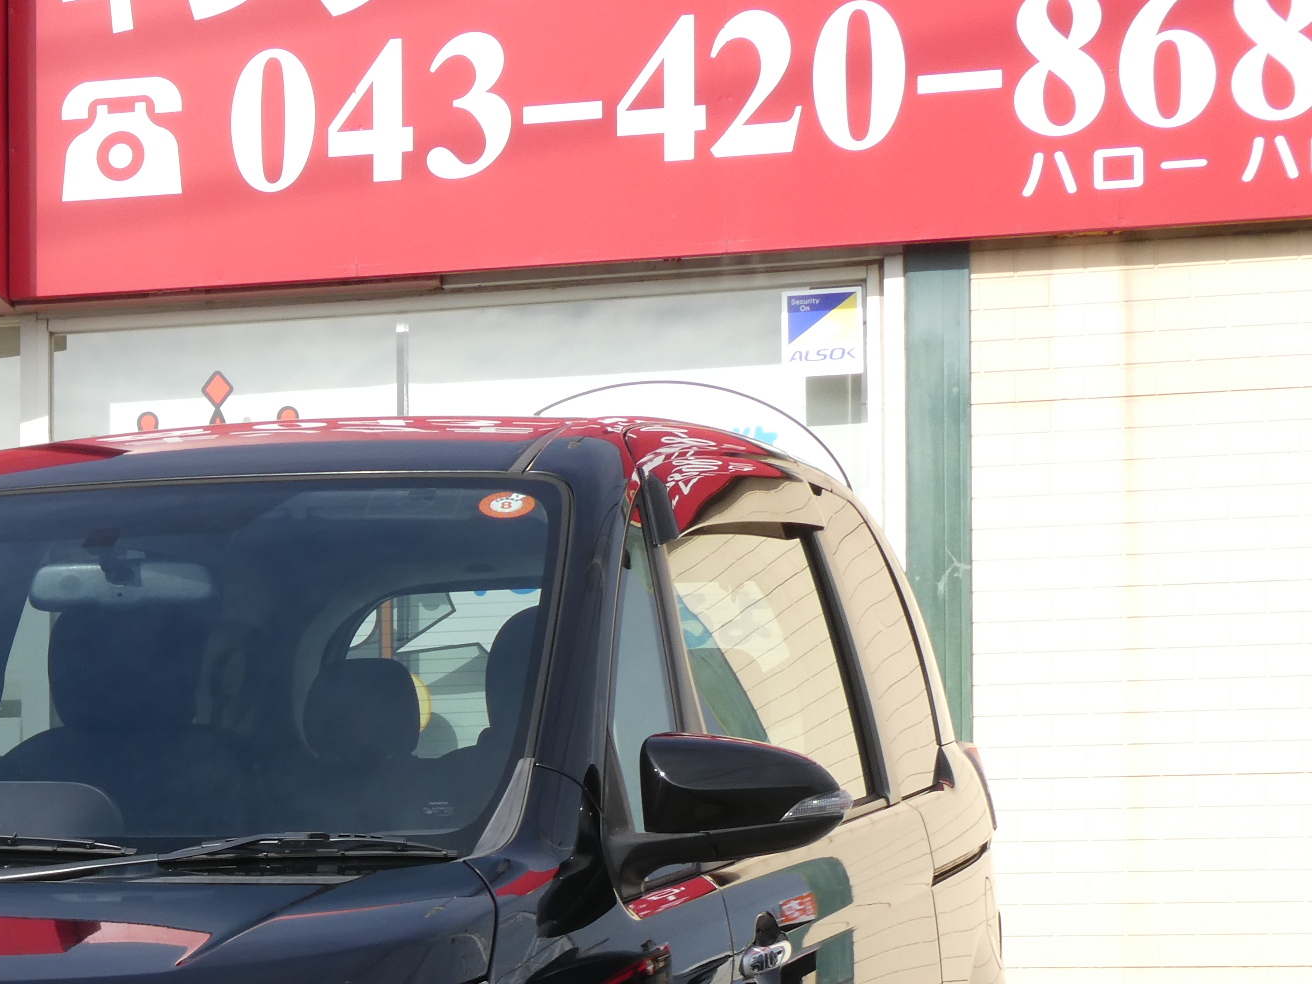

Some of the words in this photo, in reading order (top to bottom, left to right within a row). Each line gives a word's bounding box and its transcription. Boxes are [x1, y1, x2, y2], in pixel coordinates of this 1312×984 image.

[1022, 147, 1208, 197] ハロー
[1241, 135, 1312, 182] ハ
[790, 348, 856, 362] ALSOK
